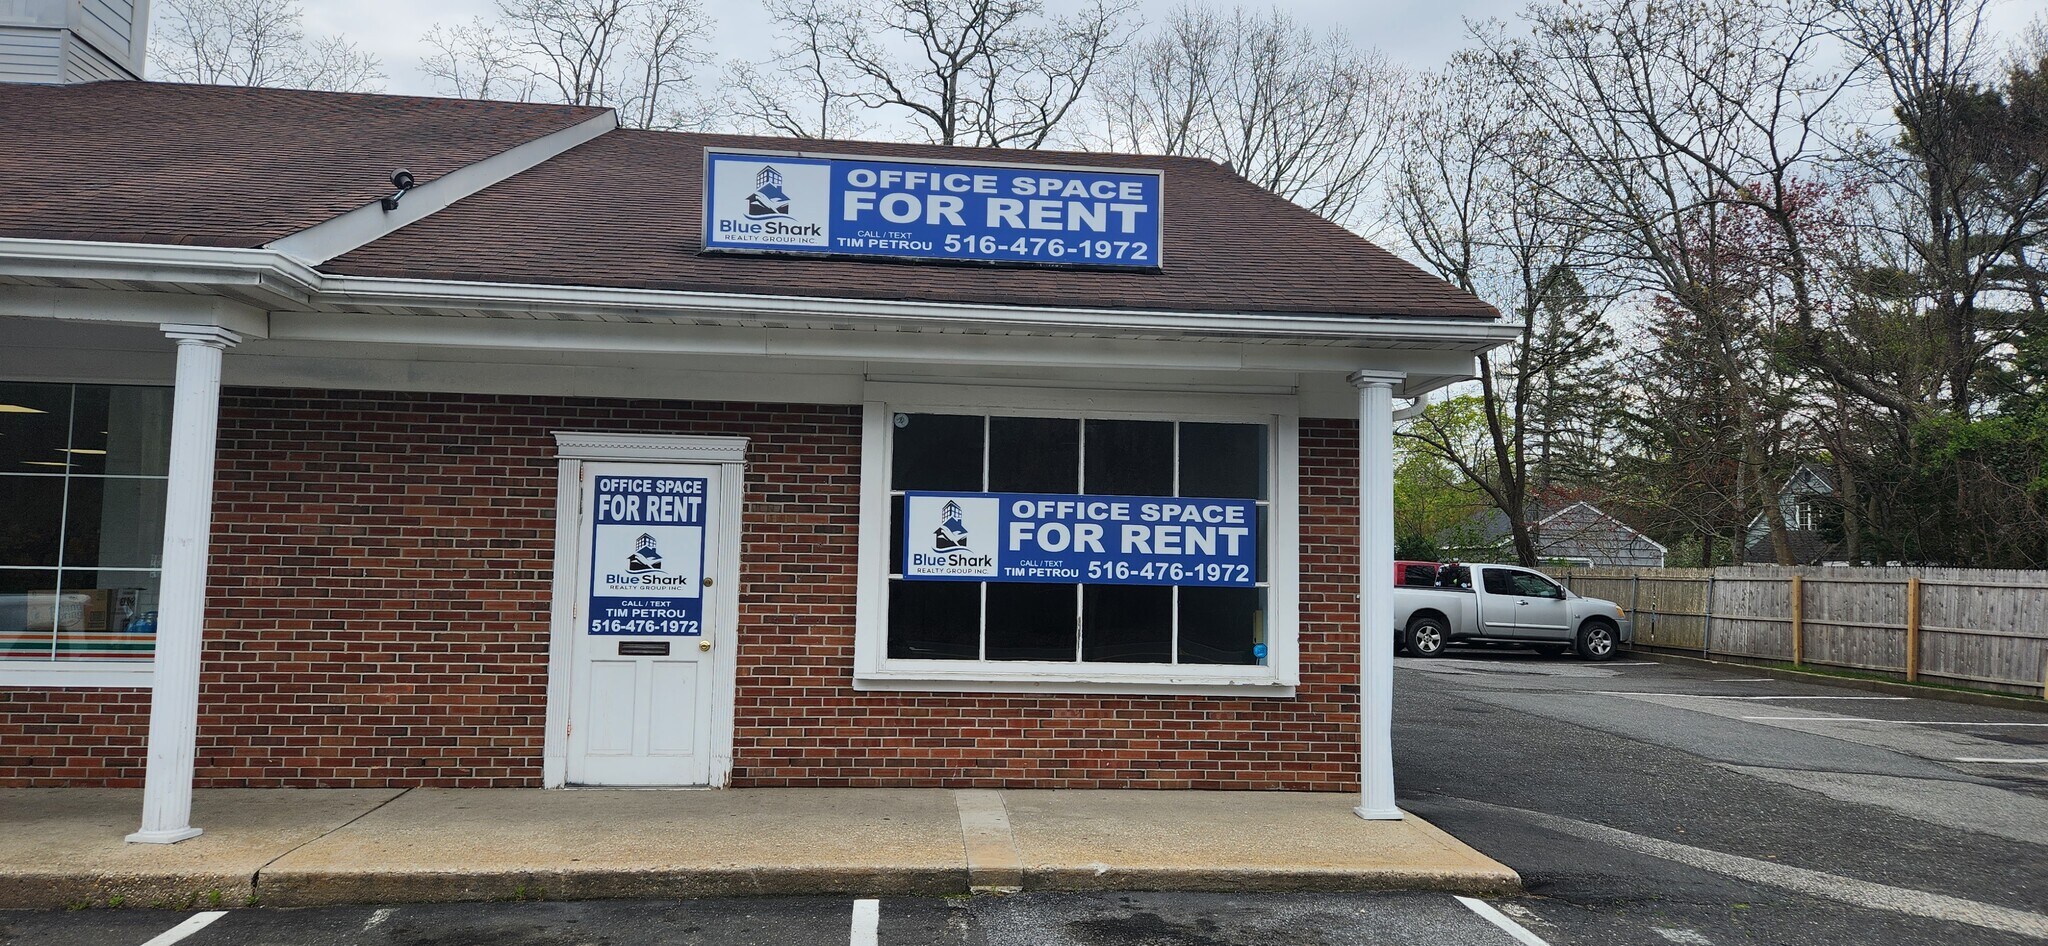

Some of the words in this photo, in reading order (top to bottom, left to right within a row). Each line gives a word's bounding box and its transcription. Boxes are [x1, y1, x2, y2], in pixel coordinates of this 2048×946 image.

[847, 169, 998, 194] OFFICE
[1011, 176, 1143, 200] SPACE
[843, 191, 966, 226] FOR
[987, 198, 1148, 234] RENT
[720, 220, 762, 233] Blue
[765, 222, 821, 236] Shark
[858, 230, 880, 238] CALL
[837, 238, 864, 247] TIM
[868, 239, 932, 251] PETROU
[945, 235, 1148, 260] 516-476-1972
[600, 479, 652, 492] OFFICE
[656, 480, 702, 493] SPACE
[599, 495, 640, 521] FOR
[646, 496, 702, 522] RENT
[1012, 501, 1130, 521] OFFICE
[1140, 503, 1245, 523] SPACE
[1009, 522, 1106, 553] FOR
[1121, 524, 1249, 556] RENT
[914, 554, 946, 565] Blue
[948, 554, 992, 567] Shark
[1004, 567, 1025, 576] TIM
[1028, 568, 1079, 577] PETROU
[1088, 561, 1249, 582] 516-476-1972
[606, 574, 639, 584] Blue
[642, 575, 687, 585] Shark
[606, 609, 628, 617] TIM
[632, 609, 685, 618] PETROU
[592, 620, 698, 632] 516-476-1972
